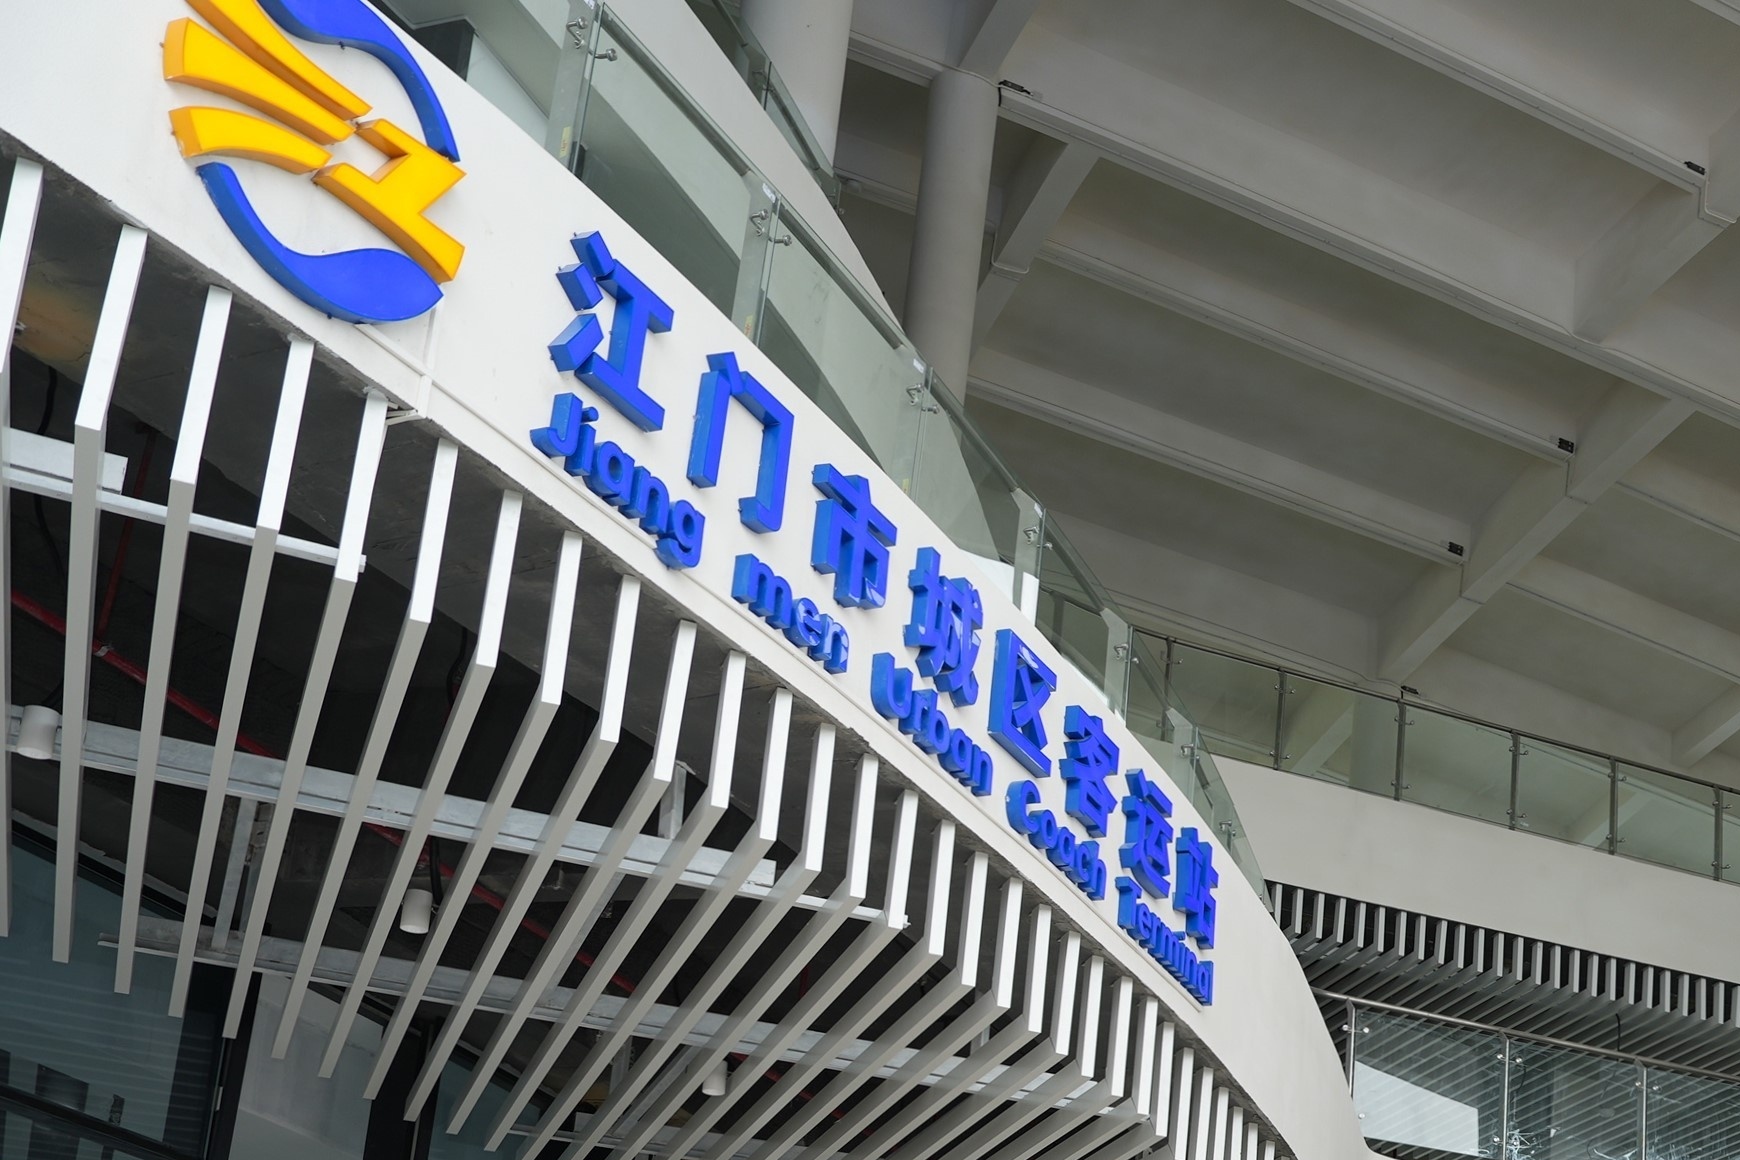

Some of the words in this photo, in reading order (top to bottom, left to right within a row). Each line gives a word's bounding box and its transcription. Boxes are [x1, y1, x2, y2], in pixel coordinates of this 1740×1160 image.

[530, 392, 706, 570] Jiang
[732, 552, 849, 674] men
[871, 652, 993, 796] Urban
[1005, 780, 1107, 901] Coach
[1115, 876, 1214, 1006] Terminal
[548, 230, 1220, 949] 江门市城区客运站
